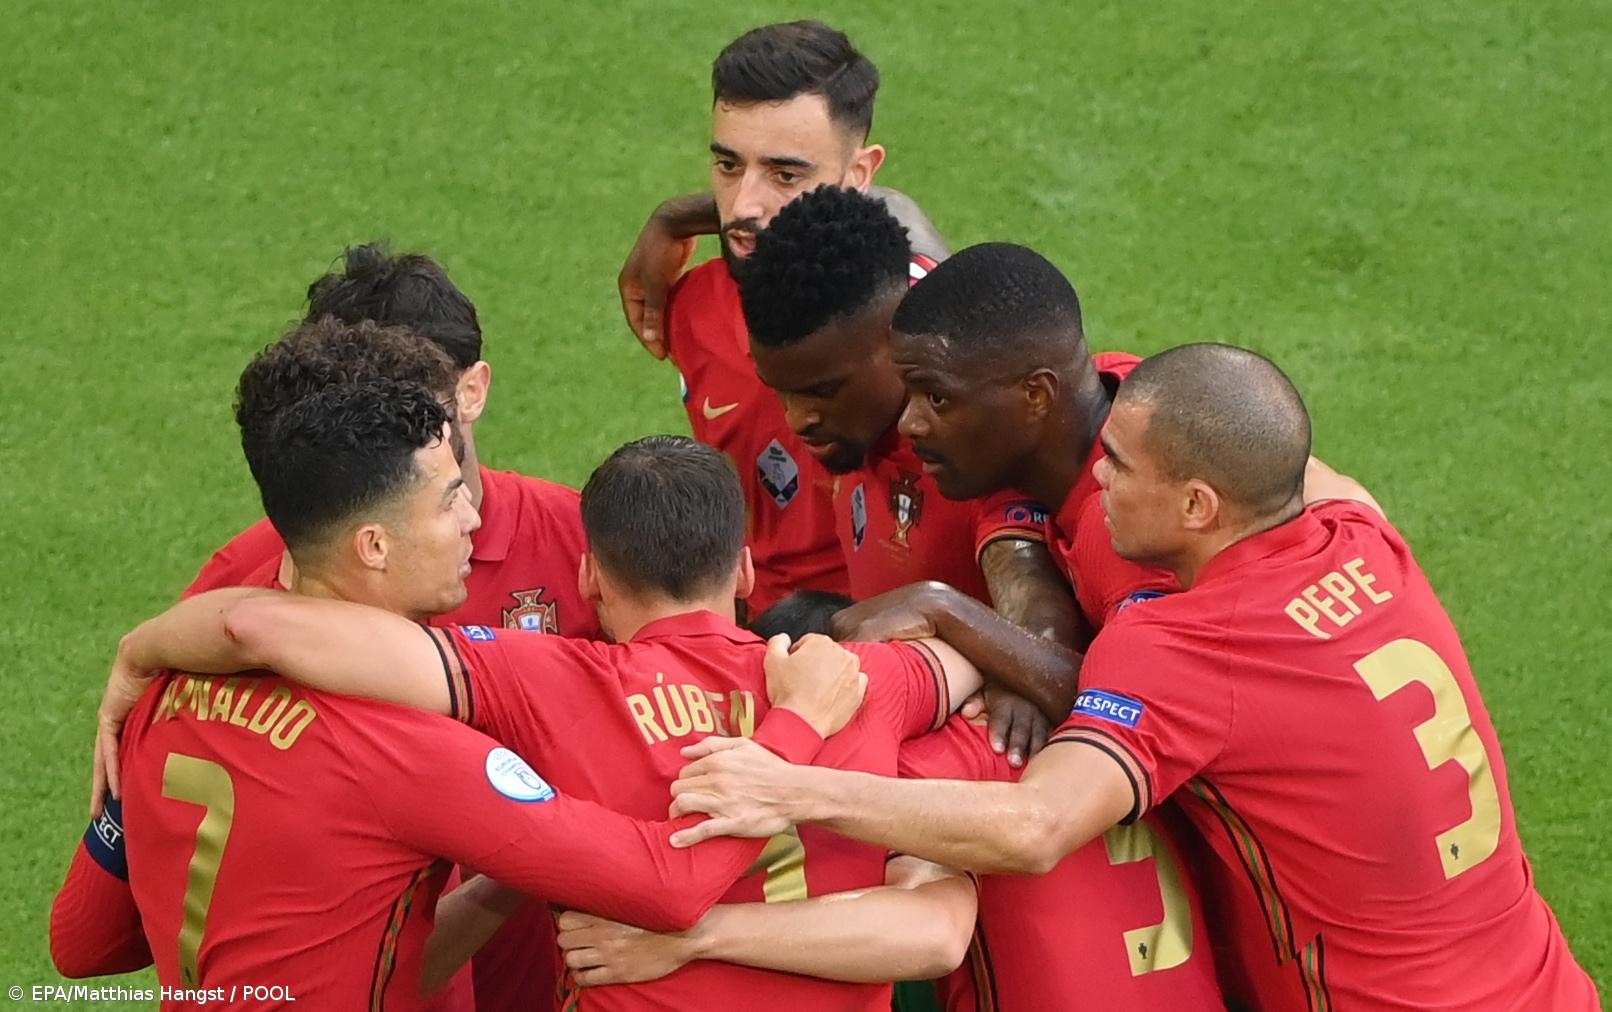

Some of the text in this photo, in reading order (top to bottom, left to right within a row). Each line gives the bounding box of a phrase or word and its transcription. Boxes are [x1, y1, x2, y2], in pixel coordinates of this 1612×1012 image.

[1284, 557, 1394, 640] PEPE
[626, 671, 756, 745] RÚBEN
[1074, 695, 1141, 722] RESPECT
[1352, 638, 1502, 880] 3
[98, 811, 122, 844] ECT
[161, 752, 235, 986] 7
